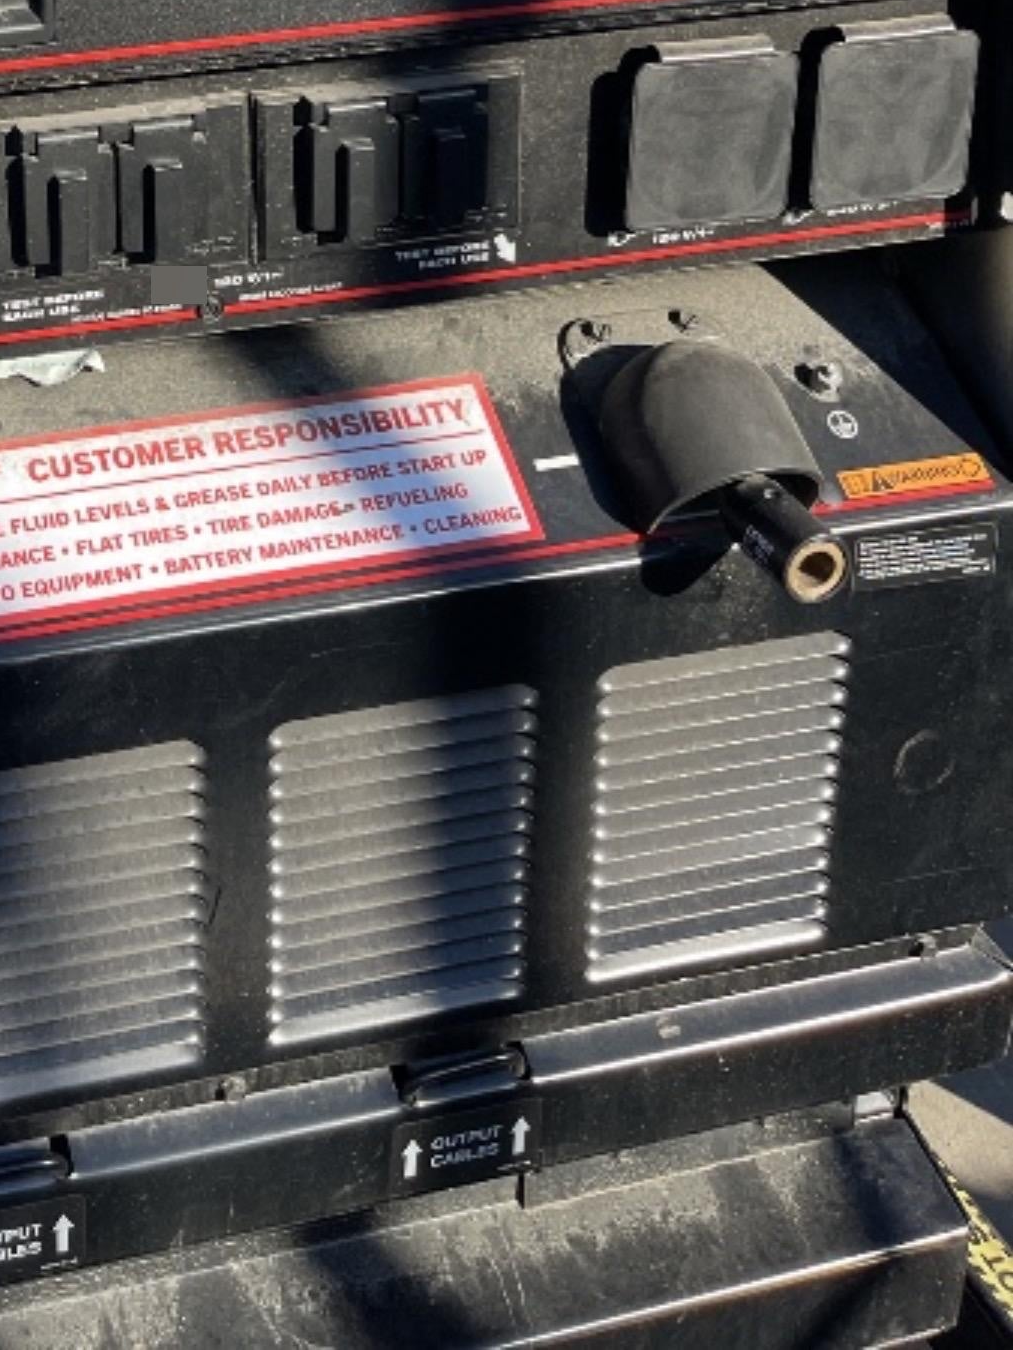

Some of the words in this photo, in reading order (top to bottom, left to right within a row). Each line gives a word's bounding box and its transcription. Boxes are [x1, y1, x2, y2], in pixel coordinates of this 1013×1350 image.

[27, 437, 207, 482] CUSTOMER
[213, 398, 464, 455] RESPONSIBILITY
[11, 512, 69, 534] FLUID
[75, 498, 149, 524] LEVELS
[155, 493, 170, 511] &
[173, 484, 250, 508] GREASE
[257, 474, 312, 496] DAILY
[317, 462, 391, 487] BEFORE
[397, 453, 455, 476] START
[462, 449, 487, 467] UP
[76, 533, 123, 556] FLAT
[128, 525, 188, 549] TIRES
[206, 514, 251, 535] TIRE
[257, 502, 340, 529] DAMAGE
[362, 482, 468, 512] REFUELING
[21, 564, 144, 599] EQUIPMENT
[163, 544, 253, 575] BATTERY
[259, 525, 405, 561] MAINTENANCE
[423, 507, 522, 535] CLEANING
[430, 1124, 504, 1150] OUTPUT
[430, 1142, 499, 1168] CABLES
